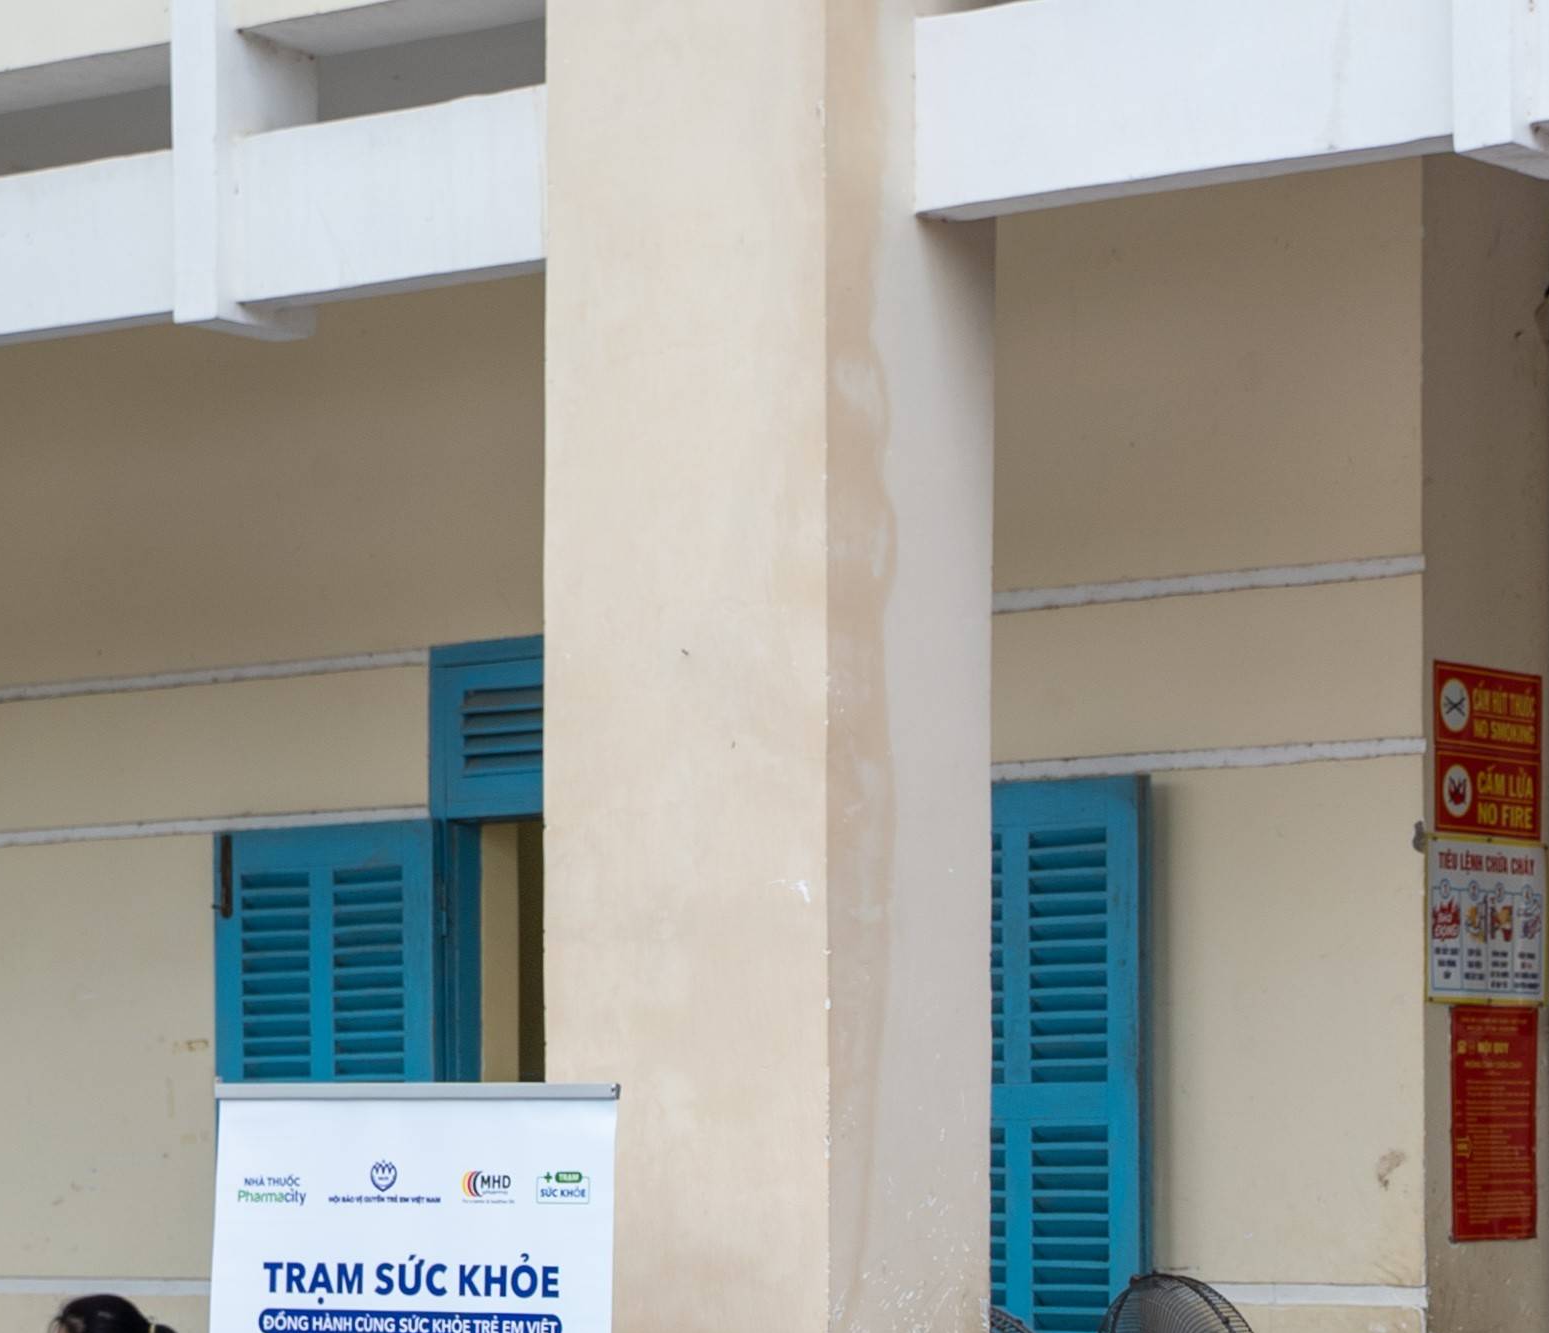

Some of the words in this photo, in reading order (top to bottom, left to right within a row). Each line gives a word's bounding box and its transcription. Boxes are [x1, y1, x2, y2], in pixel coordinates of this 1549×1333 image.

[1477, 802, 1498, 825] NO
[1503, 806, 1533, 829] FIRE
[244, 1175, 265, 1187] NHÀ
[267, 1174, 301, 1187] THUỐC
[480, 1174, 511, 1189] MHD
[237, 1188, 307, 1206] Pharmacity
[263, 1262, 364, 1304] TRẠM
[375, 1255, 448, 1296] SỨC
[458, 1253, 561, 1298] KHỎE
[262, 1311, 309, 1331] ĐỒNG
[312, 1311, 352, 1332] HÀNH
[354, 1312, 395, 1333] CÙNG
[398, 1313, 429, 1333] SỨC
